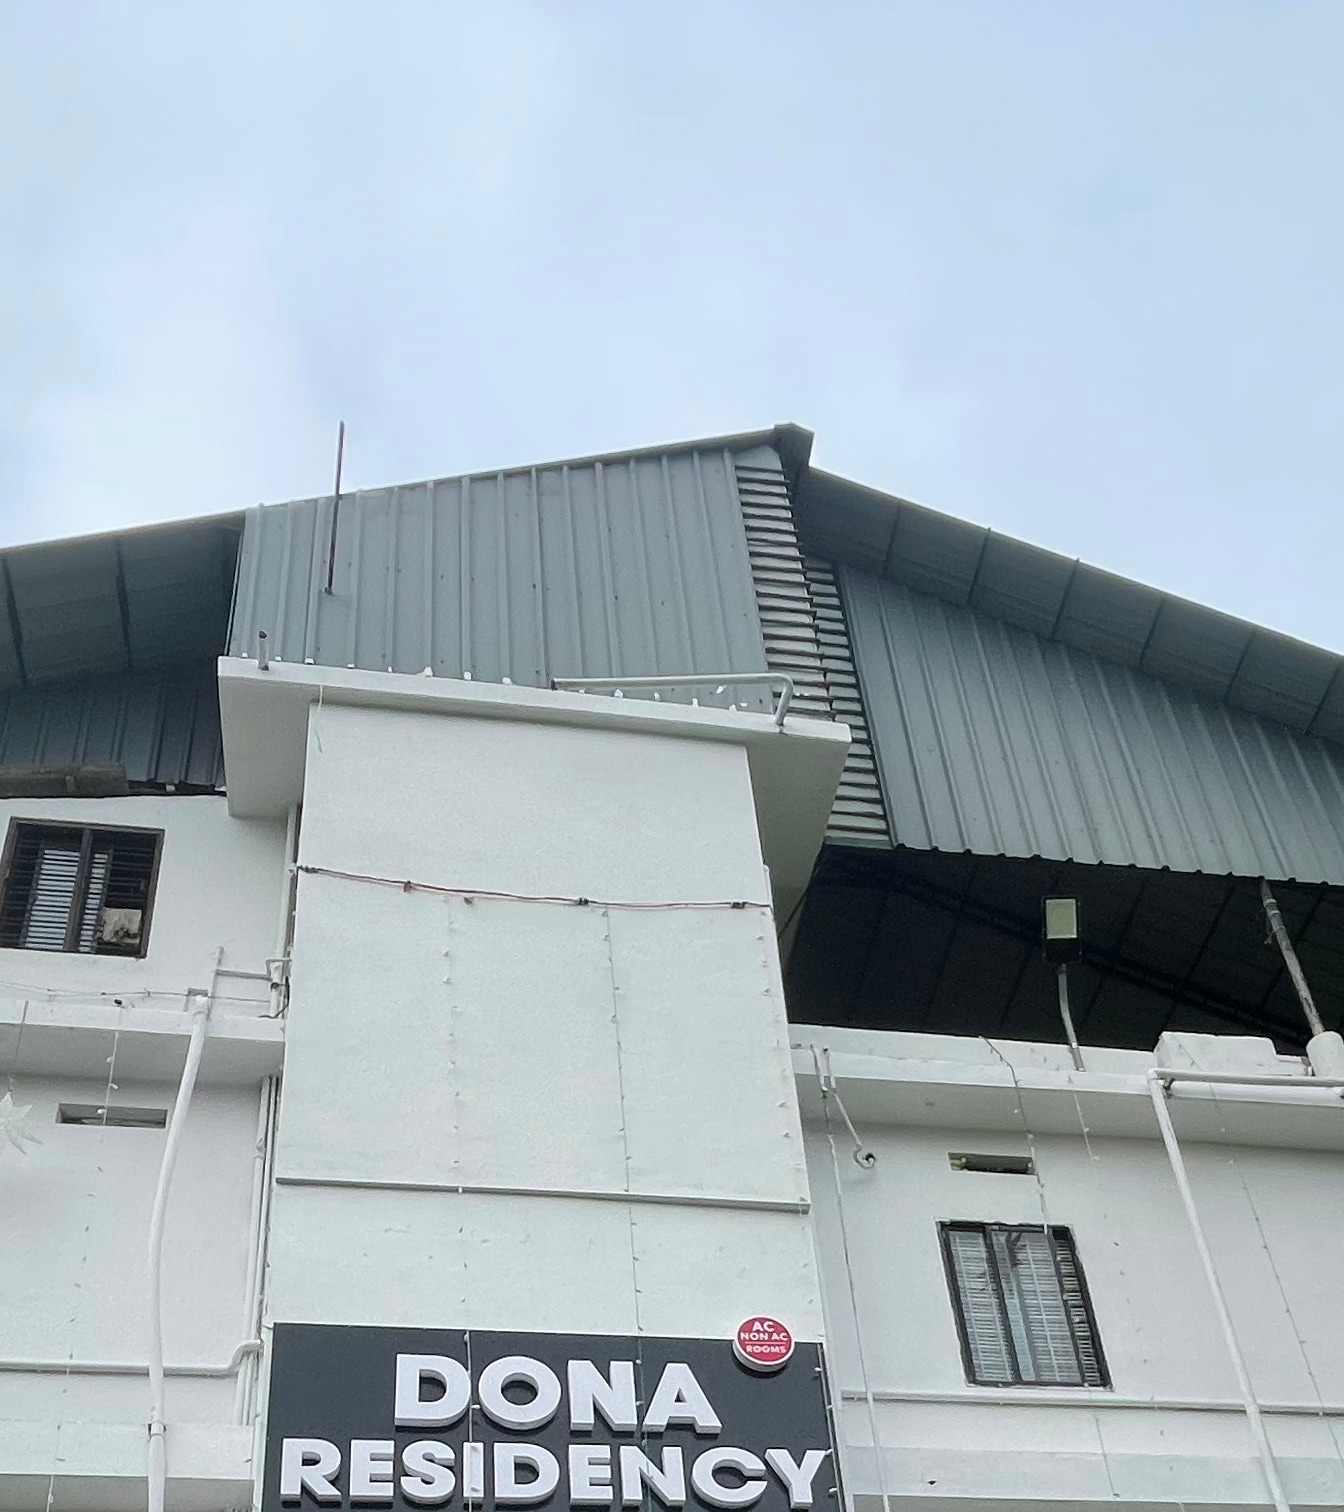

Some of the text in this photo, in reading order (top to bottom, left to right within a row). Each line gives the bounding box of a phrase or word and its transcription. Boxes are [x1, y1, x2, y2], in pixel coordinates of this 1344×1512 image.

[752, 1321, 775, 1332] AC
[740, 1332, 788, 1341] NON AC
[746, 1345, 786, 1353] ROOMS
[394, 1353, 722, 1434] DONA
[280, 1437, 832, 1510] RESIDENCY
